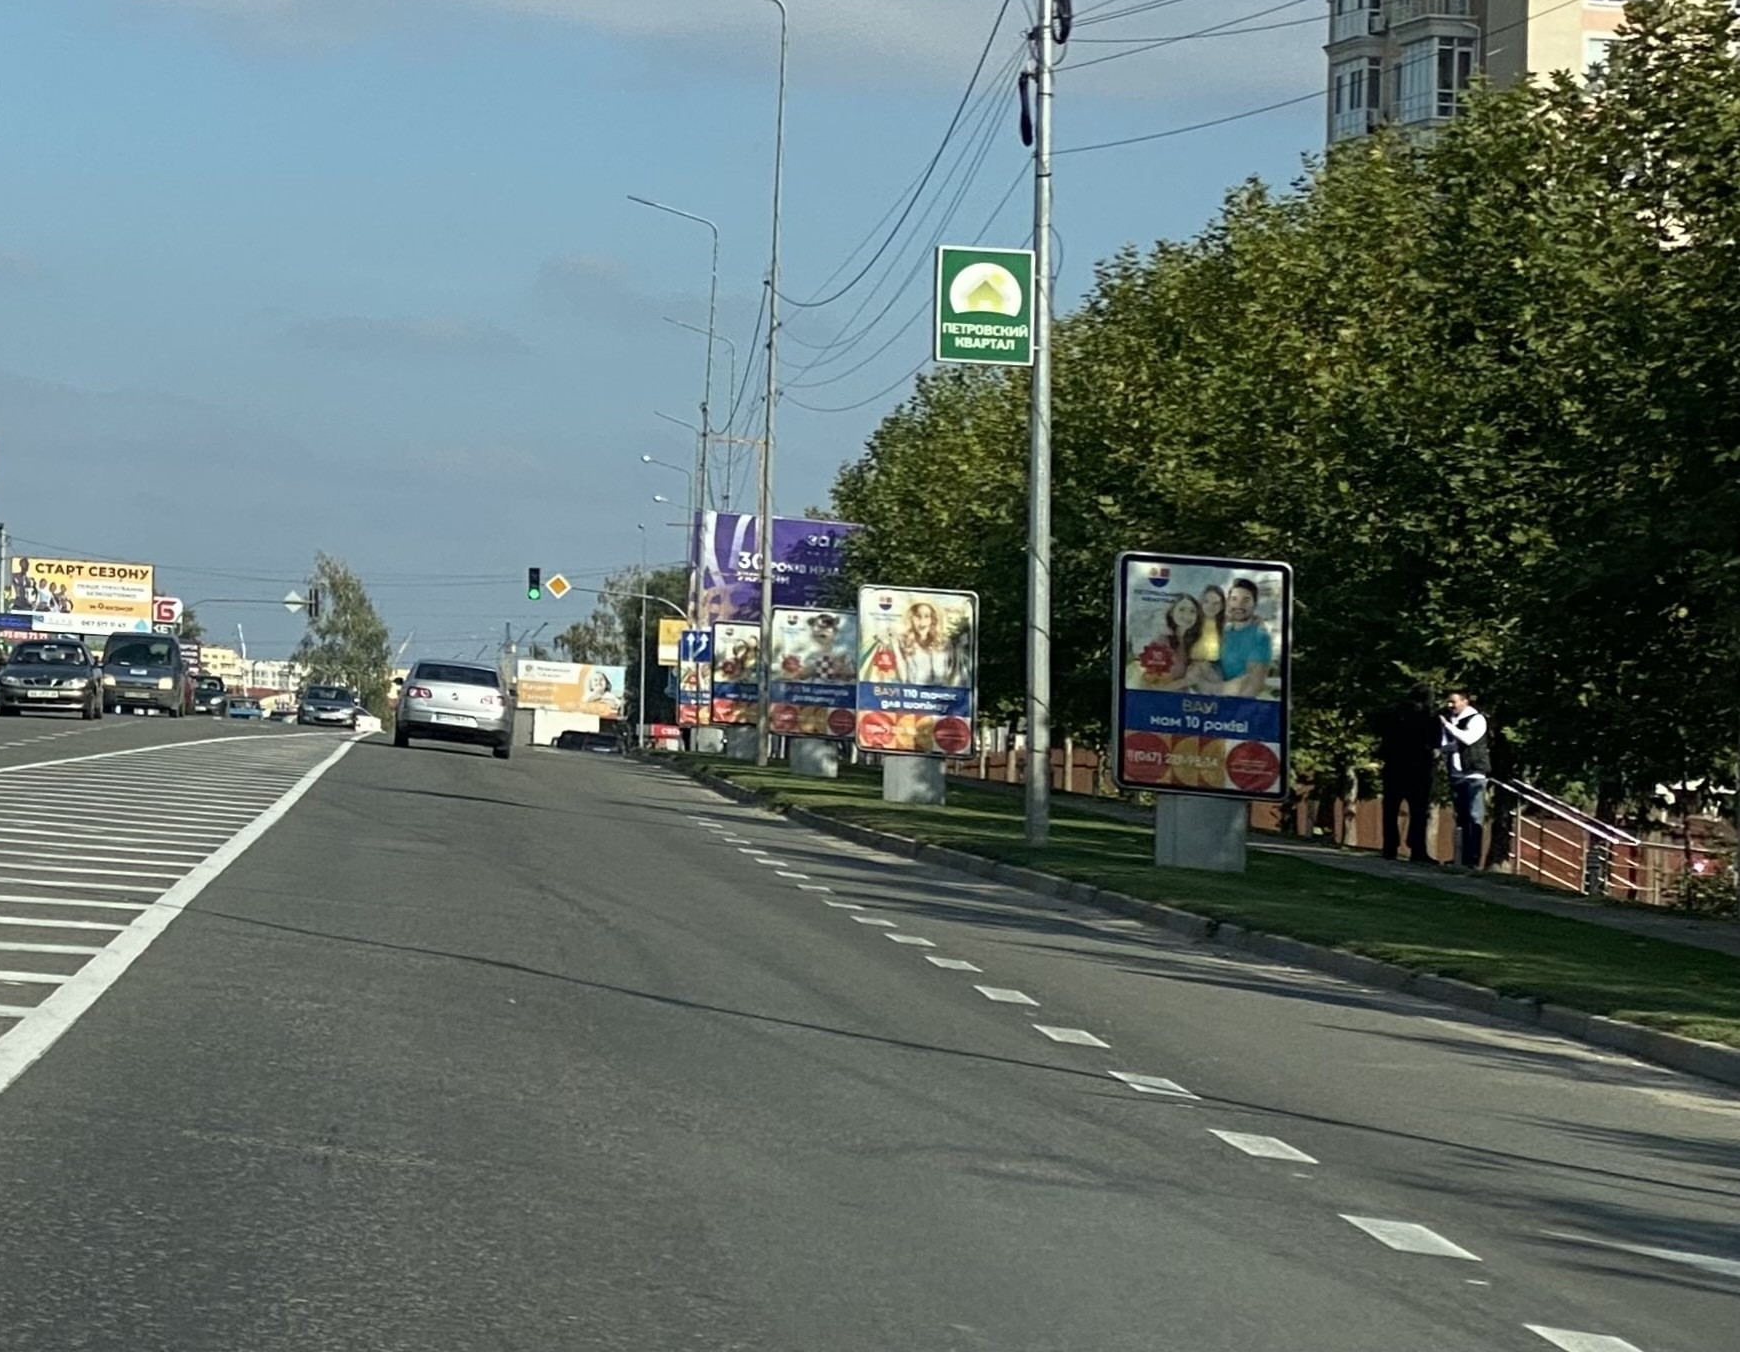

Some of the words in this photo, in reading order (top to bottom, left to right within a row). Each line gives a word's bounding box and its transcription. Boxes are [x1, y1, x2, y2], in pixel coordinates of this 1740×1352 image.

[942, 322, 1028, 337] ПЕТРОВСКИЙ
[955, 337, 1015, 350] КВАРТАЛ
[35, 563, 84, 576] СТАРТ
[89, 567, 149, 580] СЕЗОНУ
[1182, 699, 1218, 714] ВАУ!
[1185, 716, 1200, 729] 10
